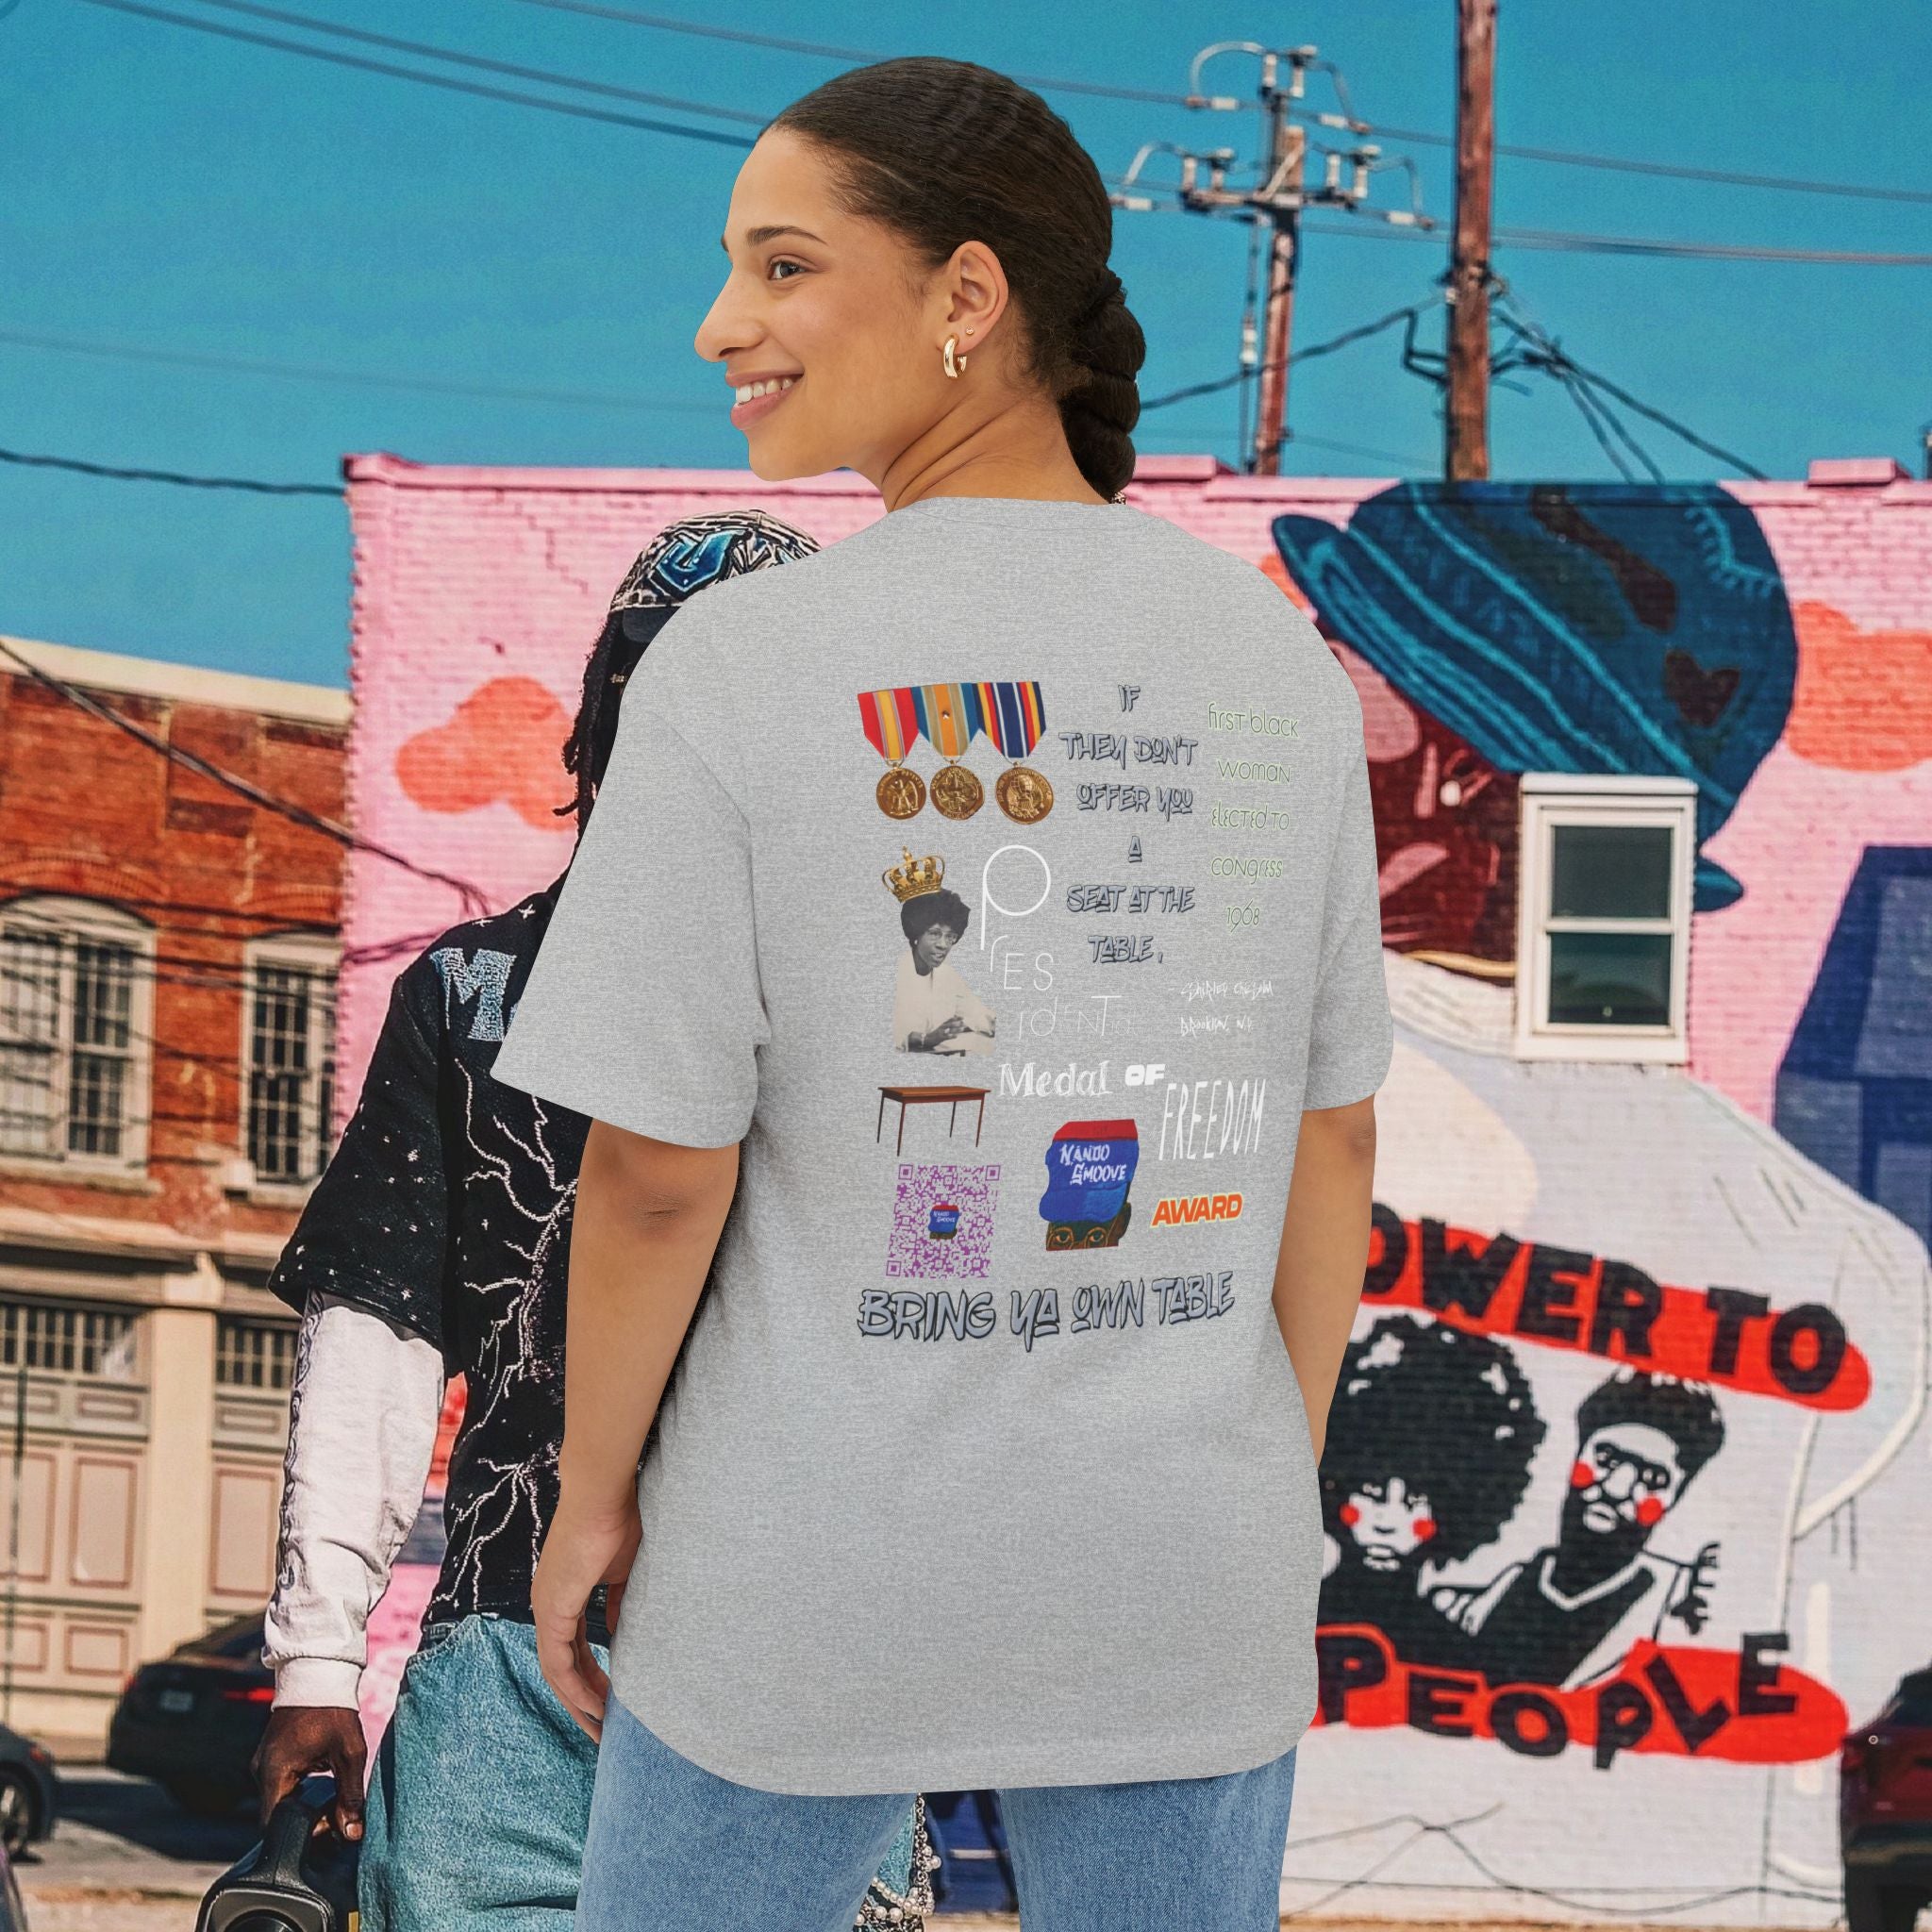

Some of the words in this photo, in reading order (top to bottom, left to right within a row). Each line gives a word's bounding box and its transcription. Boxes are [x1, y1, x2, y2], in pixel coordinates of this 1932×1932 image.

[1118, 685, 1141, 712] IF
[1058, 732, 1126, 770] THEY
[1133, 734, 1198, 766] DON'T
[1076, 783, 1150, 811] OFFER
[1156, 787, 1193, 821] YOU
[1128, 836, 1142, 863] A
[1067, 884, 1126, 913] SEAT
[1128, 885, 1157, 913] AT
[1157, 885, 1195, 913] THE
[1226, 897, 1260, 934] 1968
[998, 1060, 1114, 1097] Medal
[1124, 1063, 1166, 1086] OF
[1158, 1078, 1267, 1161] FREEDOM
[1059, 1143, 1110, 1166] NANDO
[1070, 1162, 1127, 1185] SMOOVE
[1150, 1192, 1243, 1227] AWARD
[858, 1289, 996, 1341] BRING
[1010, 1289, 1059, 1353] YA
[1071, 1278, 1145, 1333] OWN
[1151, 1271, 1236, 1324] TABLE
[1361, 1201, 1663, 1359] OWER
[1706, 1286, 1847, 1396] TO
[1315, 1632, 1799, 1772] PEOPLE
